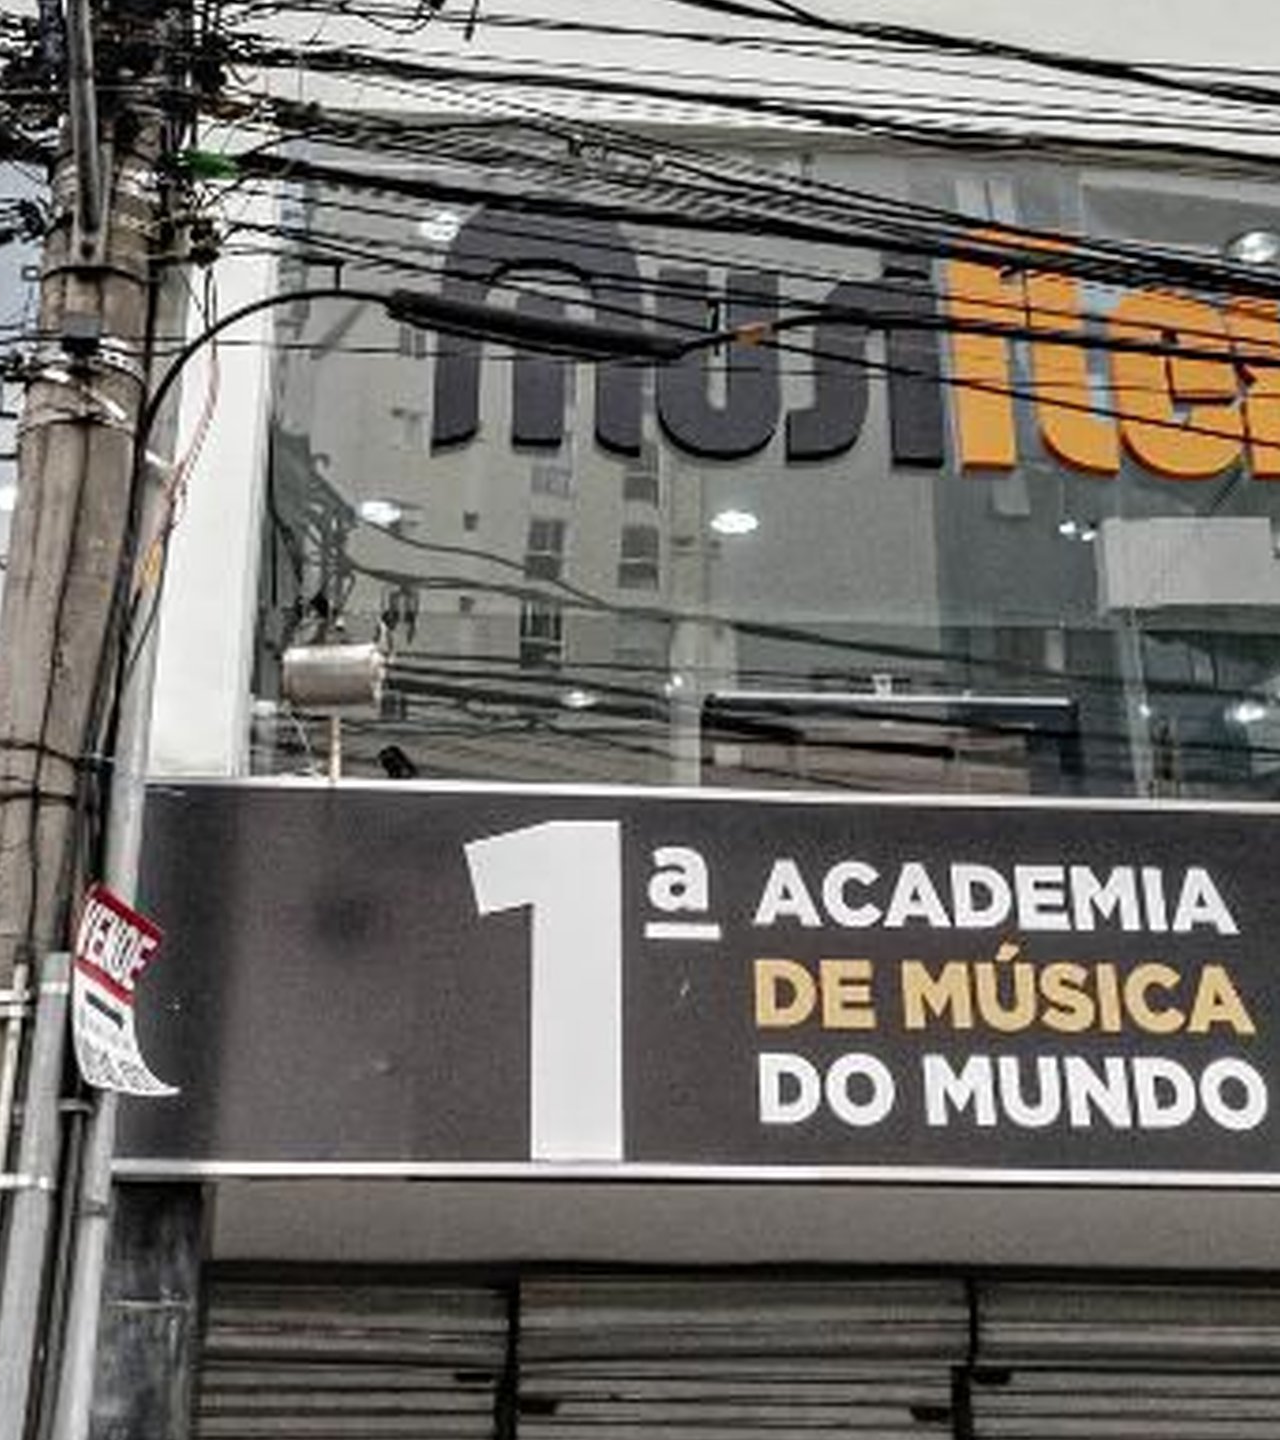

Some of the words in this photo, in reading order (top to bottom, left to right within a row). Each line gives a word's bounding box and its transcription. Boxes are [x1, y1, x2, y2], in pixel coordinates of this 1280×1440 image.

[754, 860, 1239, 934] ACADEMIA
[753, 957, 877, 1030] DE
[900, 942, 1257, 1034] MÚSICA
[758, 1052, 896, 1127] DO
[922, 1054, 1268, 1131] MUNDO
